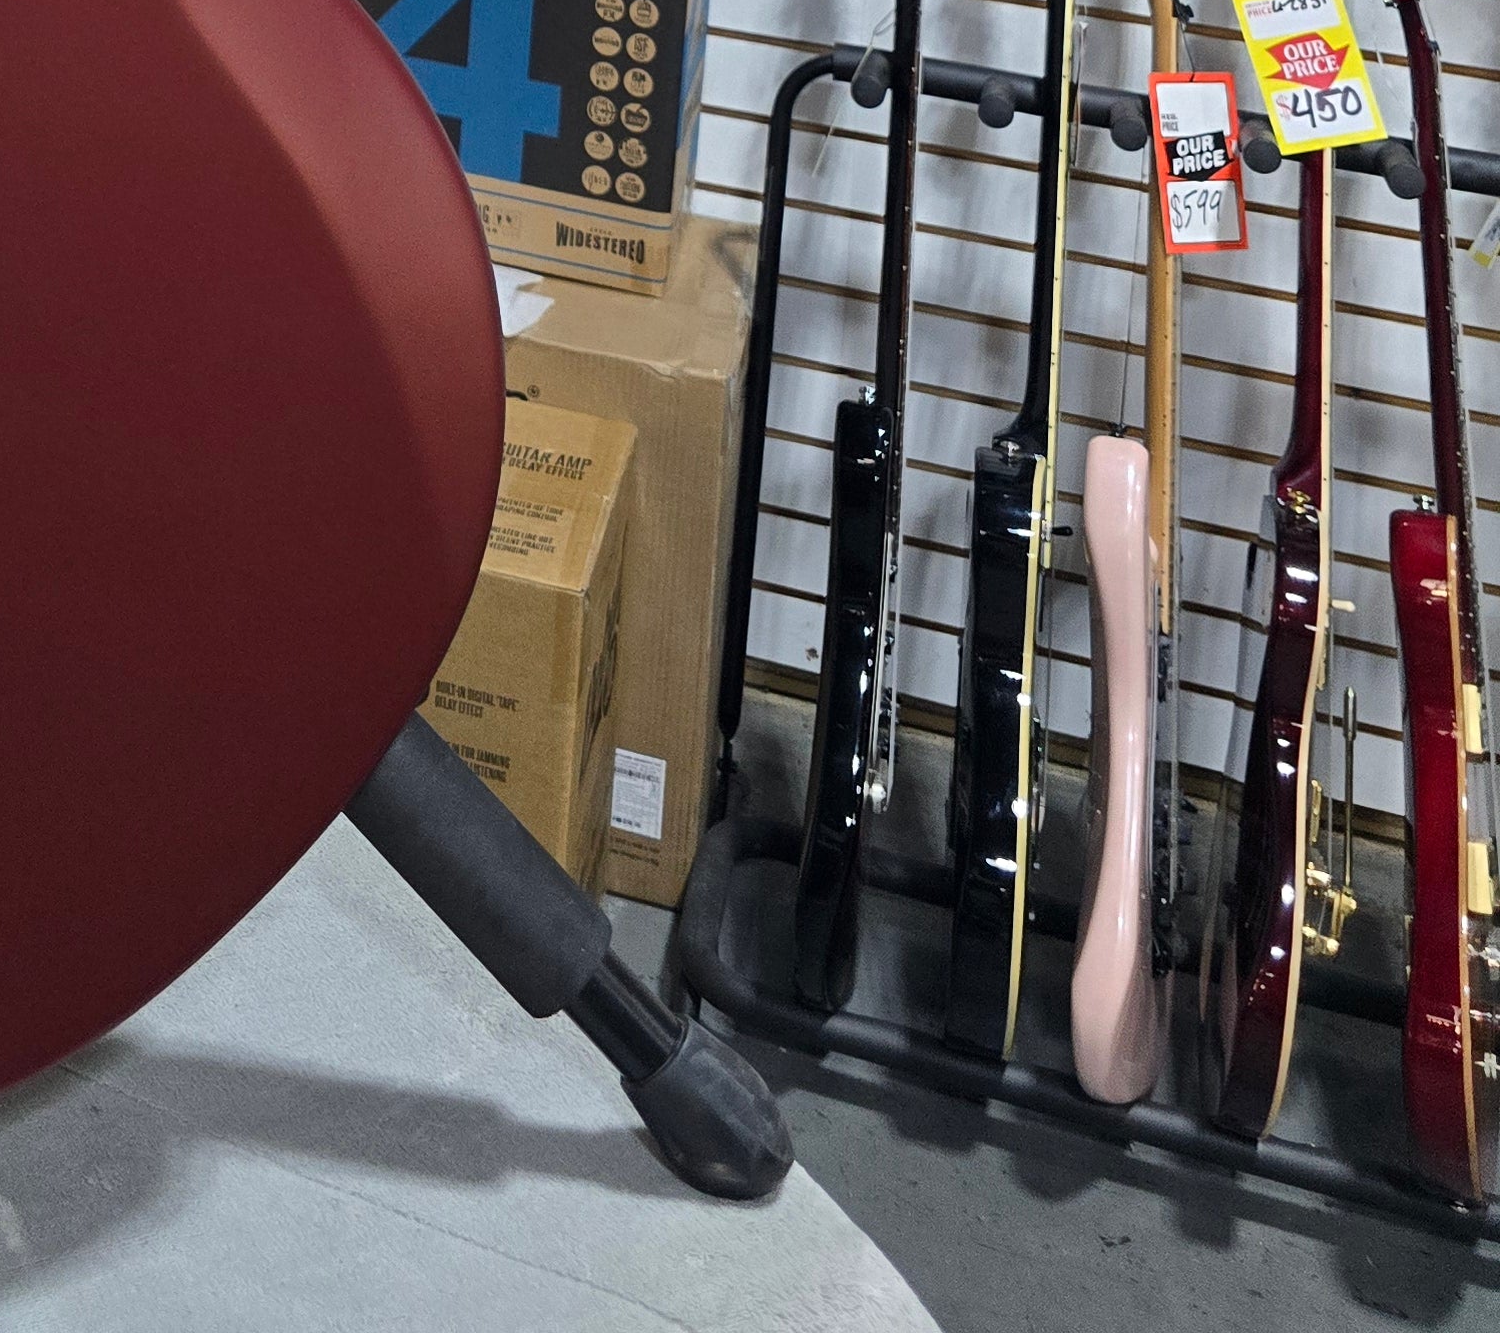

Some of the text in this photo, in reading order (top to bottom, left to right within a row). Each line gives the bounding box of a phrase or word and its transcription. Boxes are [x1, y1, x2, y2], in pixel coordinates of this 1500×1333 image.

[1247, 5, 1272, 18] PRICE
[1283, 38, 1328, 61] OUR
[1281, 54, 1340, 80] PRICE
[1275, 85, 1363, 129] $450
[1162, 121, 1179, 132] PRICE
[1176, 134, 1215, 157] OUR
[1172, 148, 1226, 176] PRICE
[1170, 189, 1223, 233] $599
[555, 221, 645, 265] WIDESTEREO
[508, 458, 586, 481] DELAY EFFECT
[555, 454, 593, 471] AMP
[458, 699, 484, 719] EFFECT
[476, 749, 511, 770] JAMMING
